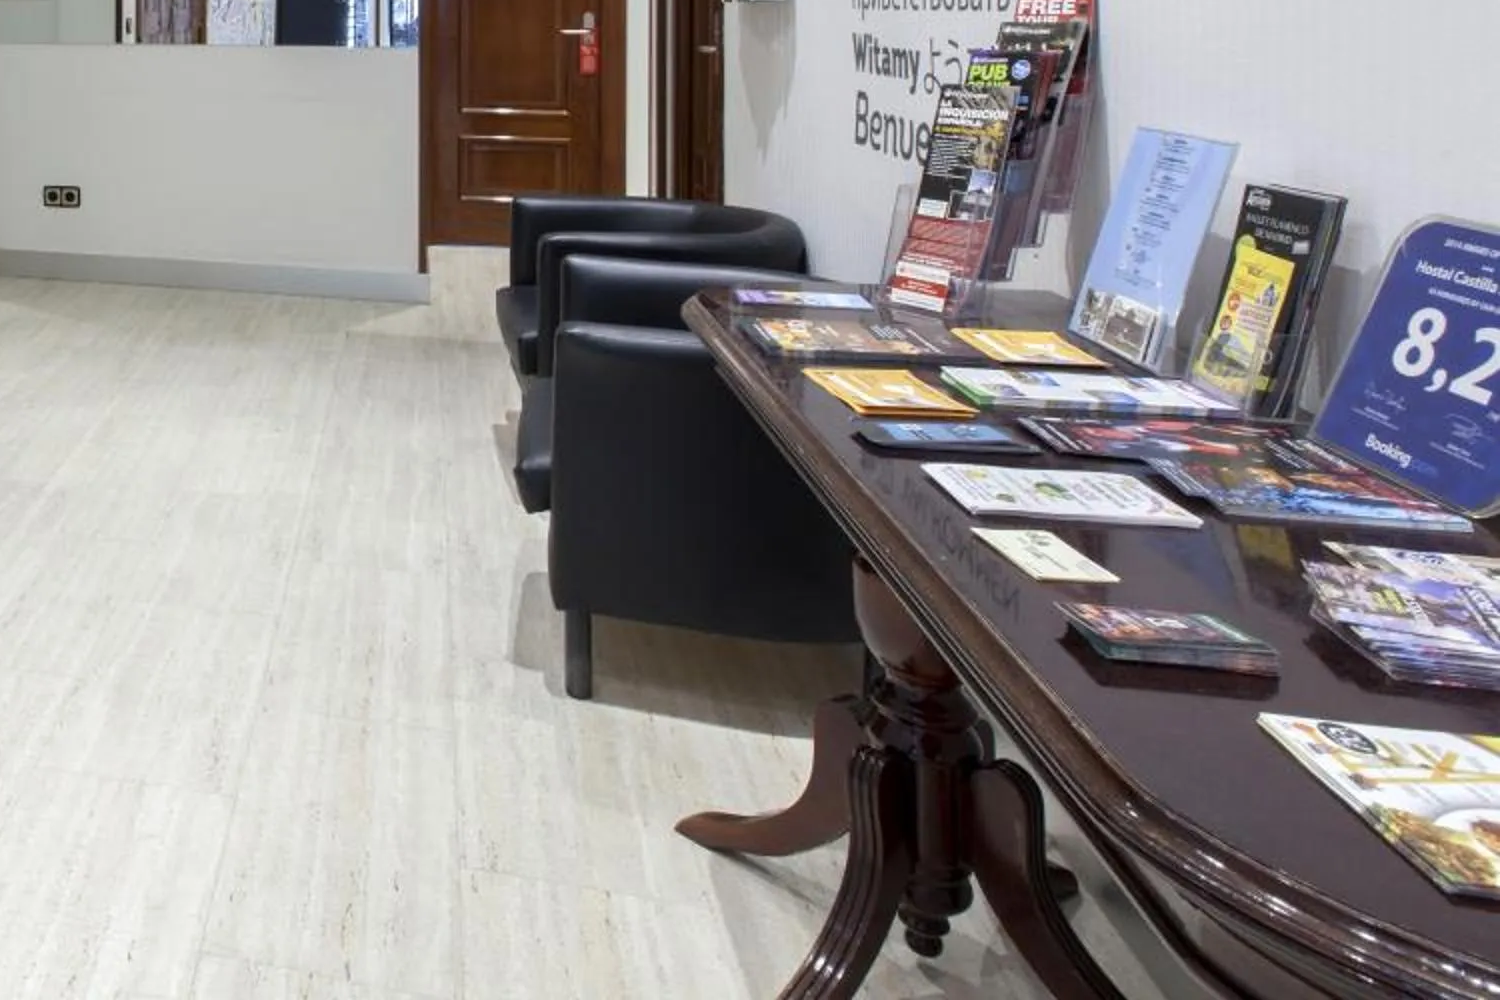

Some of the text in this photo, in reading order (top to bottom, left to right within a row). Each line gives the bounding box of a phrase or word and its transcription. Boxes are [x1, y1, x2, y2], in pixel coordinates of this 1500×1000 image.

[852, 32, 921, 94] Witamy
[969, 65, 1009, 81] PUB
[1415, 260, 1498, 294] Hostal Castilla
[1392, 307, 1500, 406] 8,2
